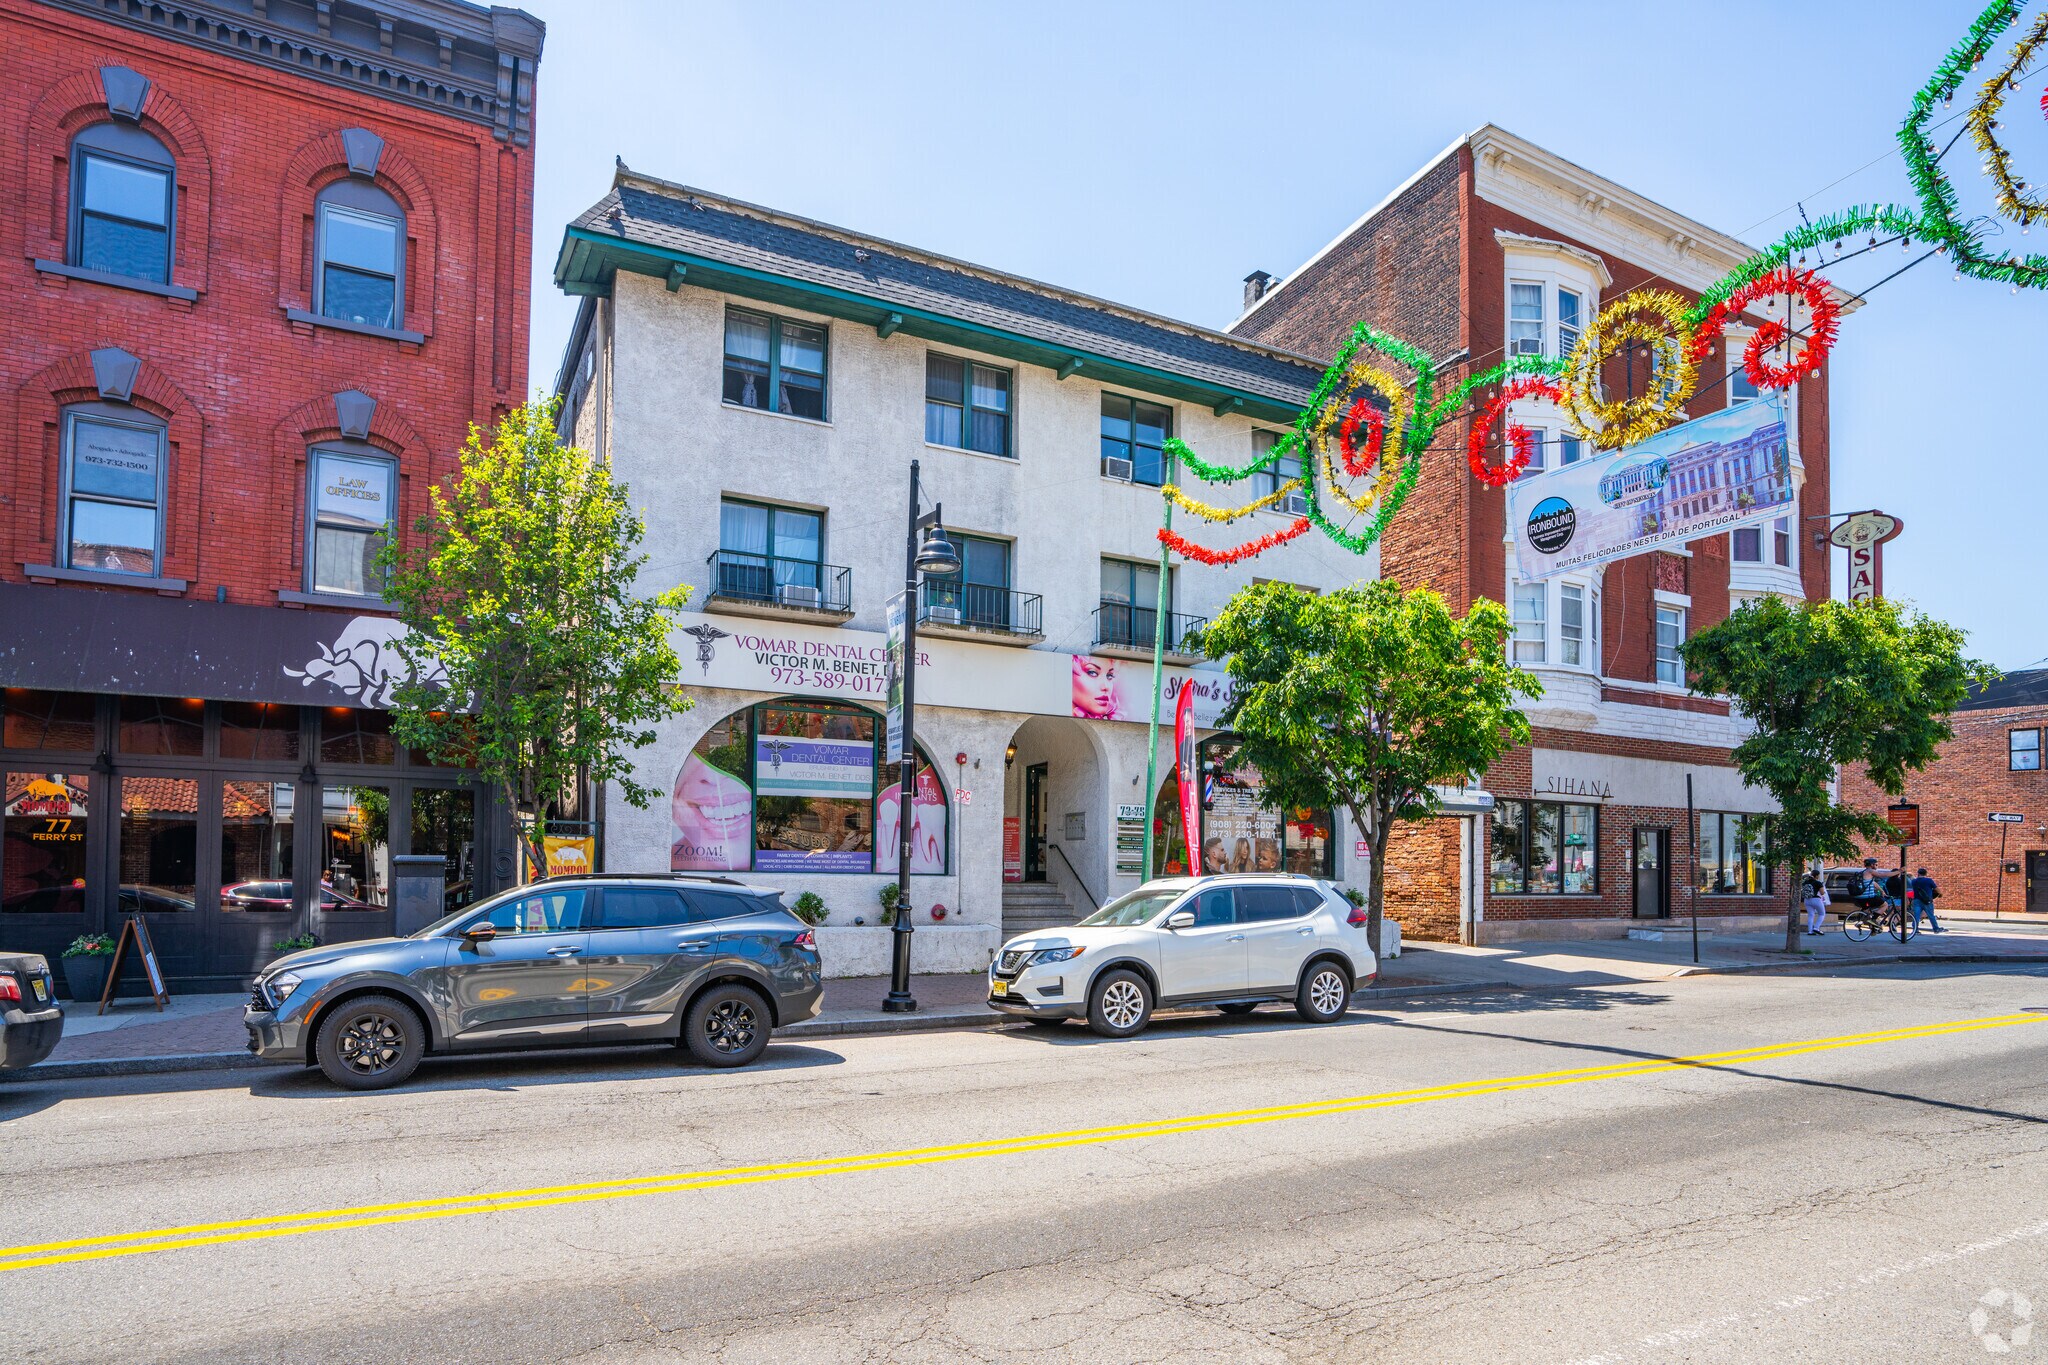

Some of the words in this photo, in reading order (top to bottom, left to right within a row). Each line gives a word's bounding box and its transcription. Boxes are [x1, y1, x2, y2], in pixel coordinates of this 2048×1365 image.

[85, 455, 148, 470] 973-732-1500
[339, 476, 368, 489] LAW
[326, 485, 380, 501] OFFICES
[1528, 513, 1574, 535] IRONBOUND
[1555, 556, 1582, 569] MUITAS
[1583, 542, 1632, 561] FELICIDADES
[1633, 534, 1660, 548] NESTE
[1661, 530, 1676, 540] DIA
[1678, 526, 1690, 536] DE
[1692, 513, 1740, 532] PORTUGAL
[734, 634, 798, 655] VOMAR
[803, 641, 866, 661] DENTAL
[869, 648, 931, 667] CEER
[755, 652, 809, 670] VICTOR
[812, 661, 829, 671] M.
[833, 661, 880, 676] BENET,
[813, 745, 849, 755] VOMAR
[791, 753, 829, 764] DENTAL
[831, 756, 870, 768] CENTER
[790, 770, 817, 778] VICTOR
[1547, 776, 1611, 797] SIHANA
[955, 788, 971, 801] FDC
[1120, 805, 1145, 816] 73-75
[45, 818, 71, 832] 77
[1210, 820, 1232, 829] (908)
[1235, 820, 1277, 830] 220-6004
[32, 833, 67, 841] FERRY
[69, 833, 84, 841] ST
[1210, 830, 1232, 839] (973)
[1235, 830, 1276, 839] 230-1671
[673, 844, 723, 857] ZOOM!
